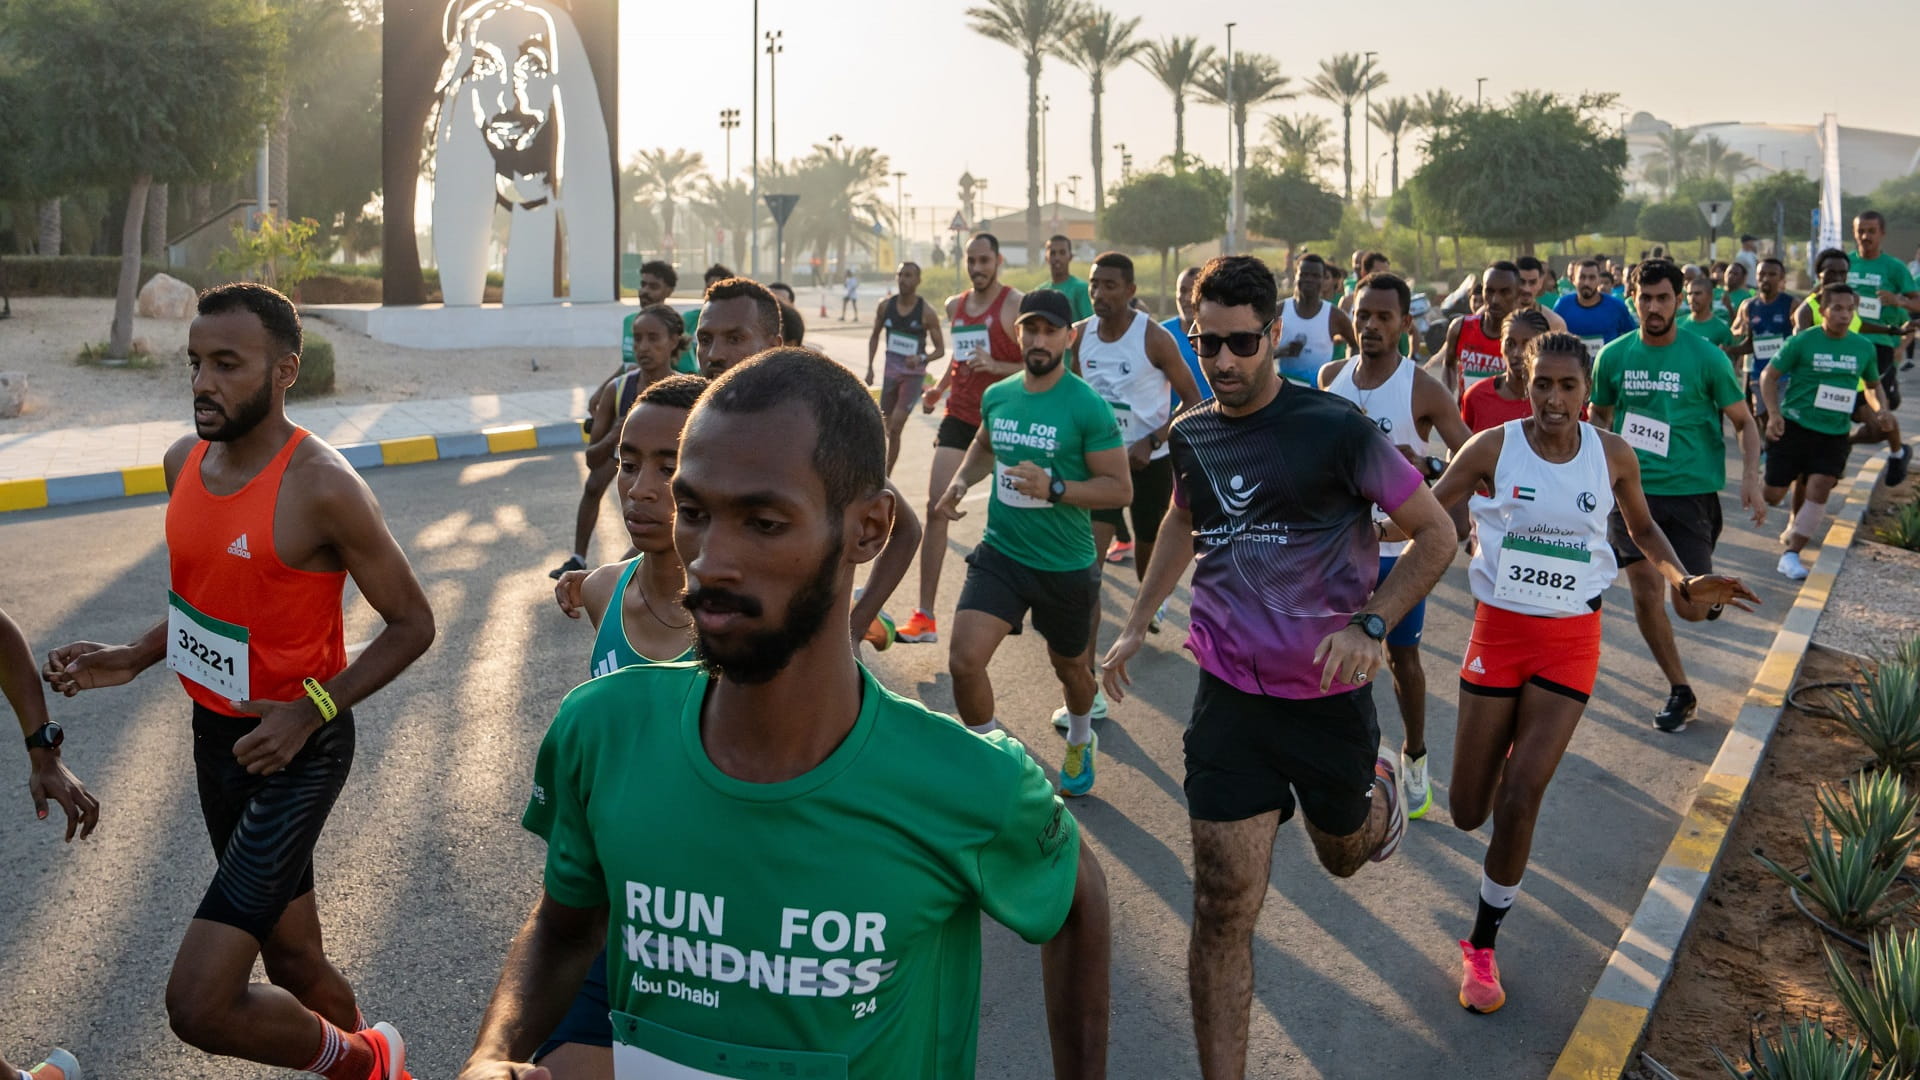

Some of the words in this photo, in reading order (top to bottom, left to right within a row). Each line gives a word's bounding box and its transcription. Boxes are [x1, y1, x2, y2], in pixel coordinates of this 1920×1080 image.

[1624, 370, 1649, 380] RUN
[1659, 371, 1681, 382] FOR
[1624, 380, 1680, 393] KINDNESS
[993, 418, 1018, 431] RUN
[1029, 423, 1057, 438] FOR
[1629, 423, 1665, 443] 32142
[991, 430, 1057, 451] KINDNESS
[227, 546, 252, 559] adidas
[1508, 565, 1577, 592] 32882
[178, 628, 235, 677] 32221
[625, 880, 725, 936] RUN
[780, 907, 887, 953] FOR
[626, 924, 884, 998] KINDNESS
[631, 971, 663, 994] Abu
[667, 979, 720, 1009] Dhabi
[851, 997, 877, 1020] '24
